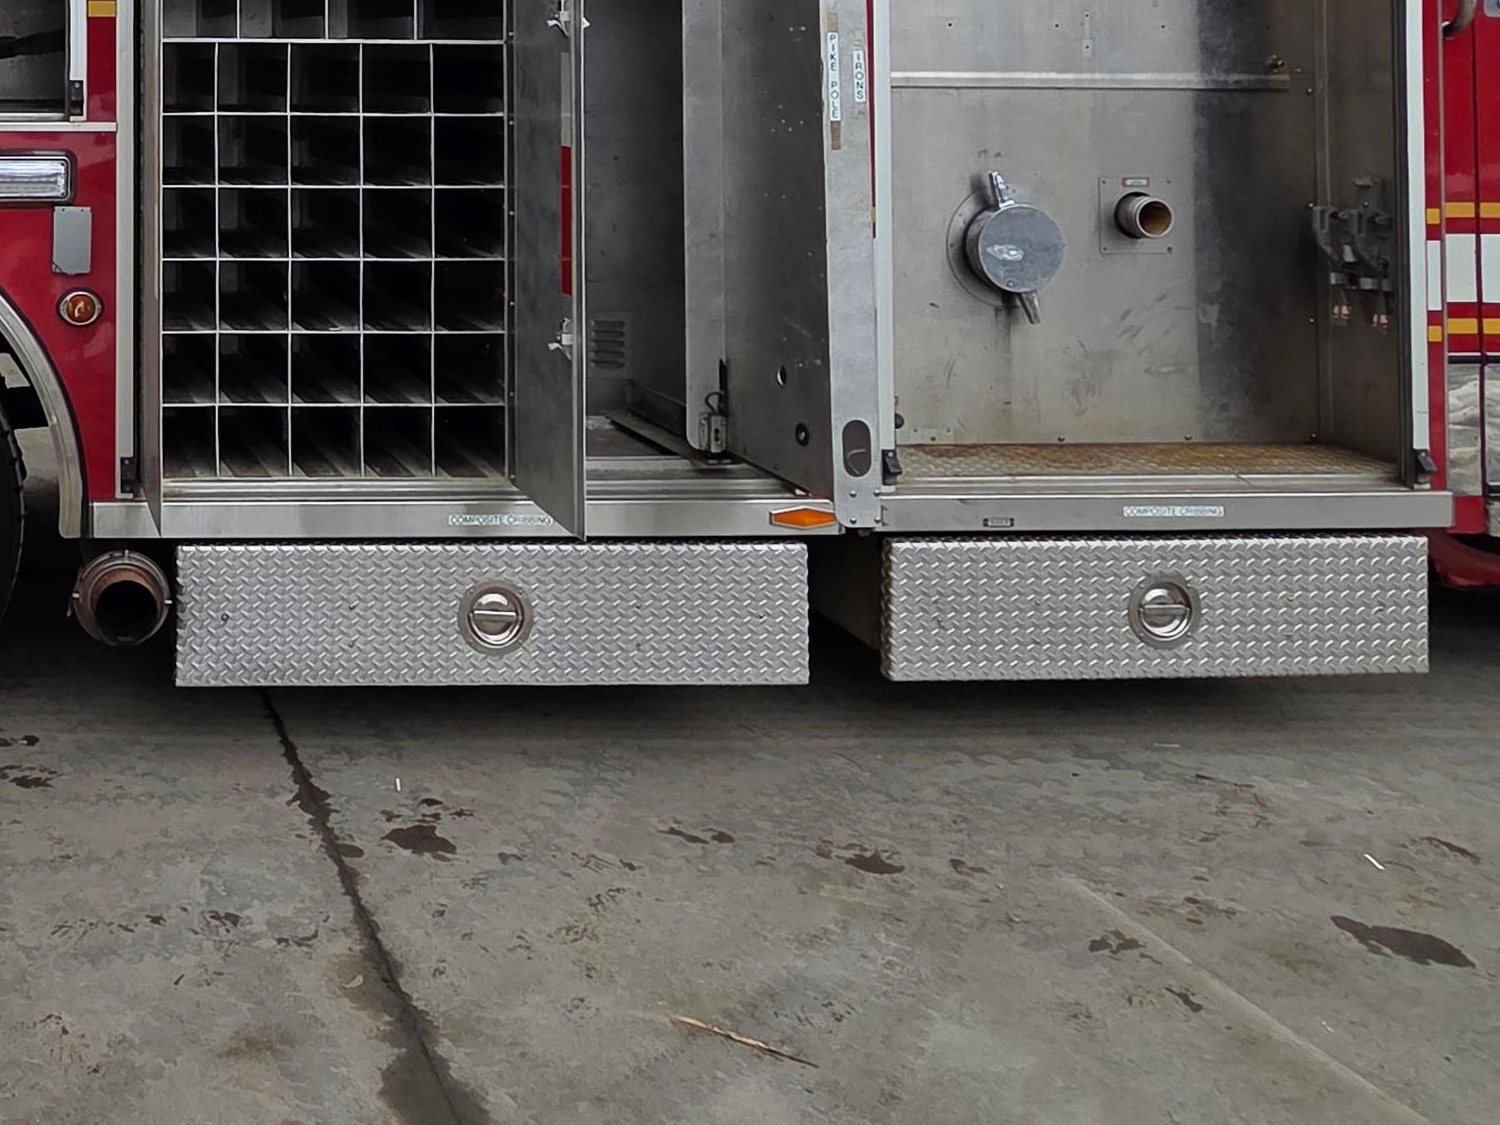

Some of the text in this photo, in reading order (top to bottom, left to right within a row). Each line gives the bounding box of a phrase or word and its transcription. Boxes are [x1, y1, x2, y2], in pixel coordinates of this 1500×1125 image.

[829, 34, 840, 119] PIKE POLE
[854, 53, 865, 100] IRONS
[450, 514, 504, 525] COMPOSITE
